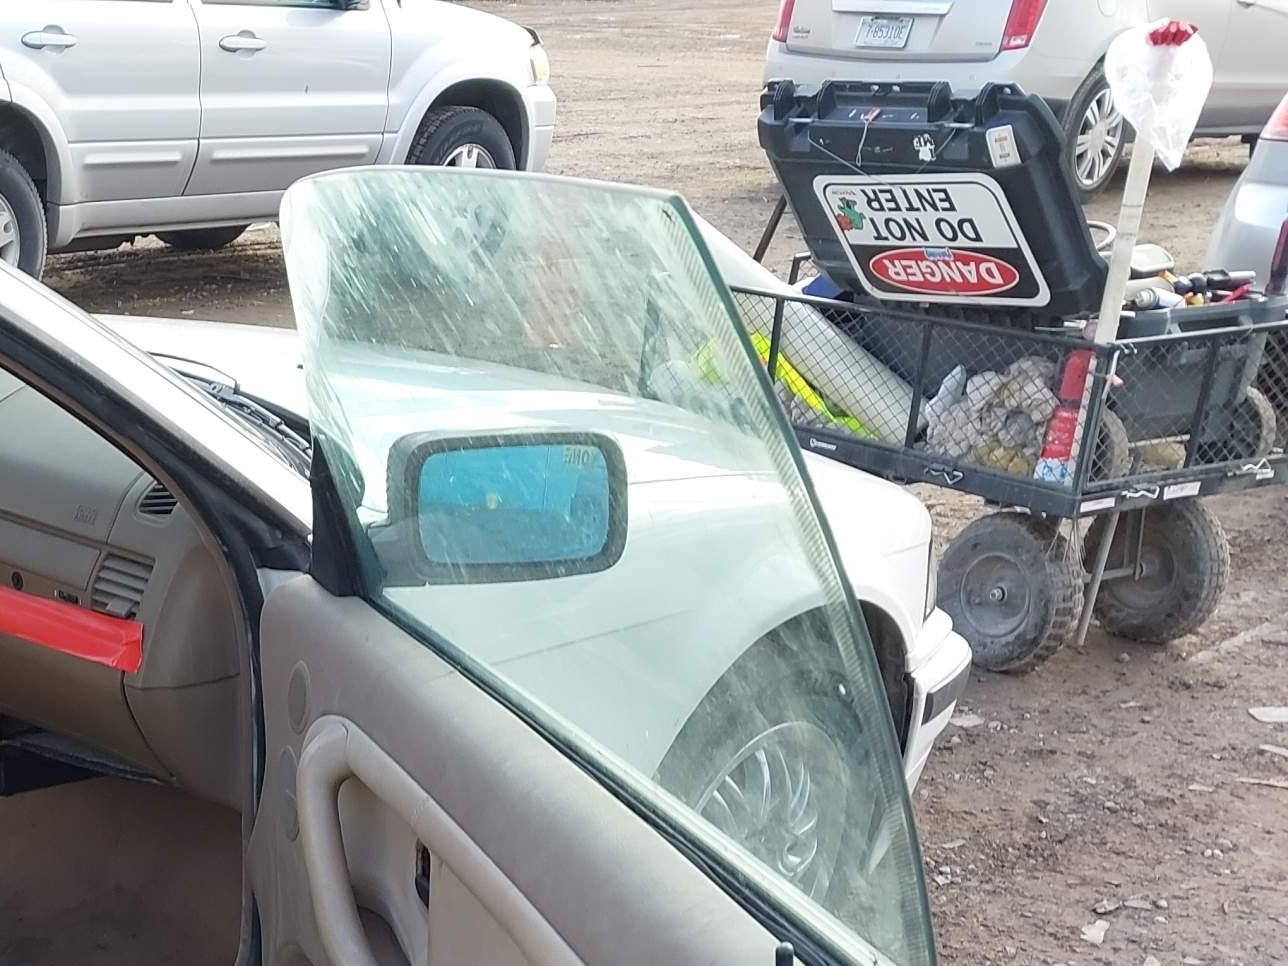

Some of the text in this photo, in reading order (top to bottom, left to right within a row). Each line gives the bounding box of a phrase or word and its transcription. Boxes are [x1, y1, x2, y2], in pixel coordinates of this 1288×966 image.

[861, 187, 957, 212] ENTER
[869, 217, 983, 243] DO NOT
[883, 258, 1004, 284] DANGER
